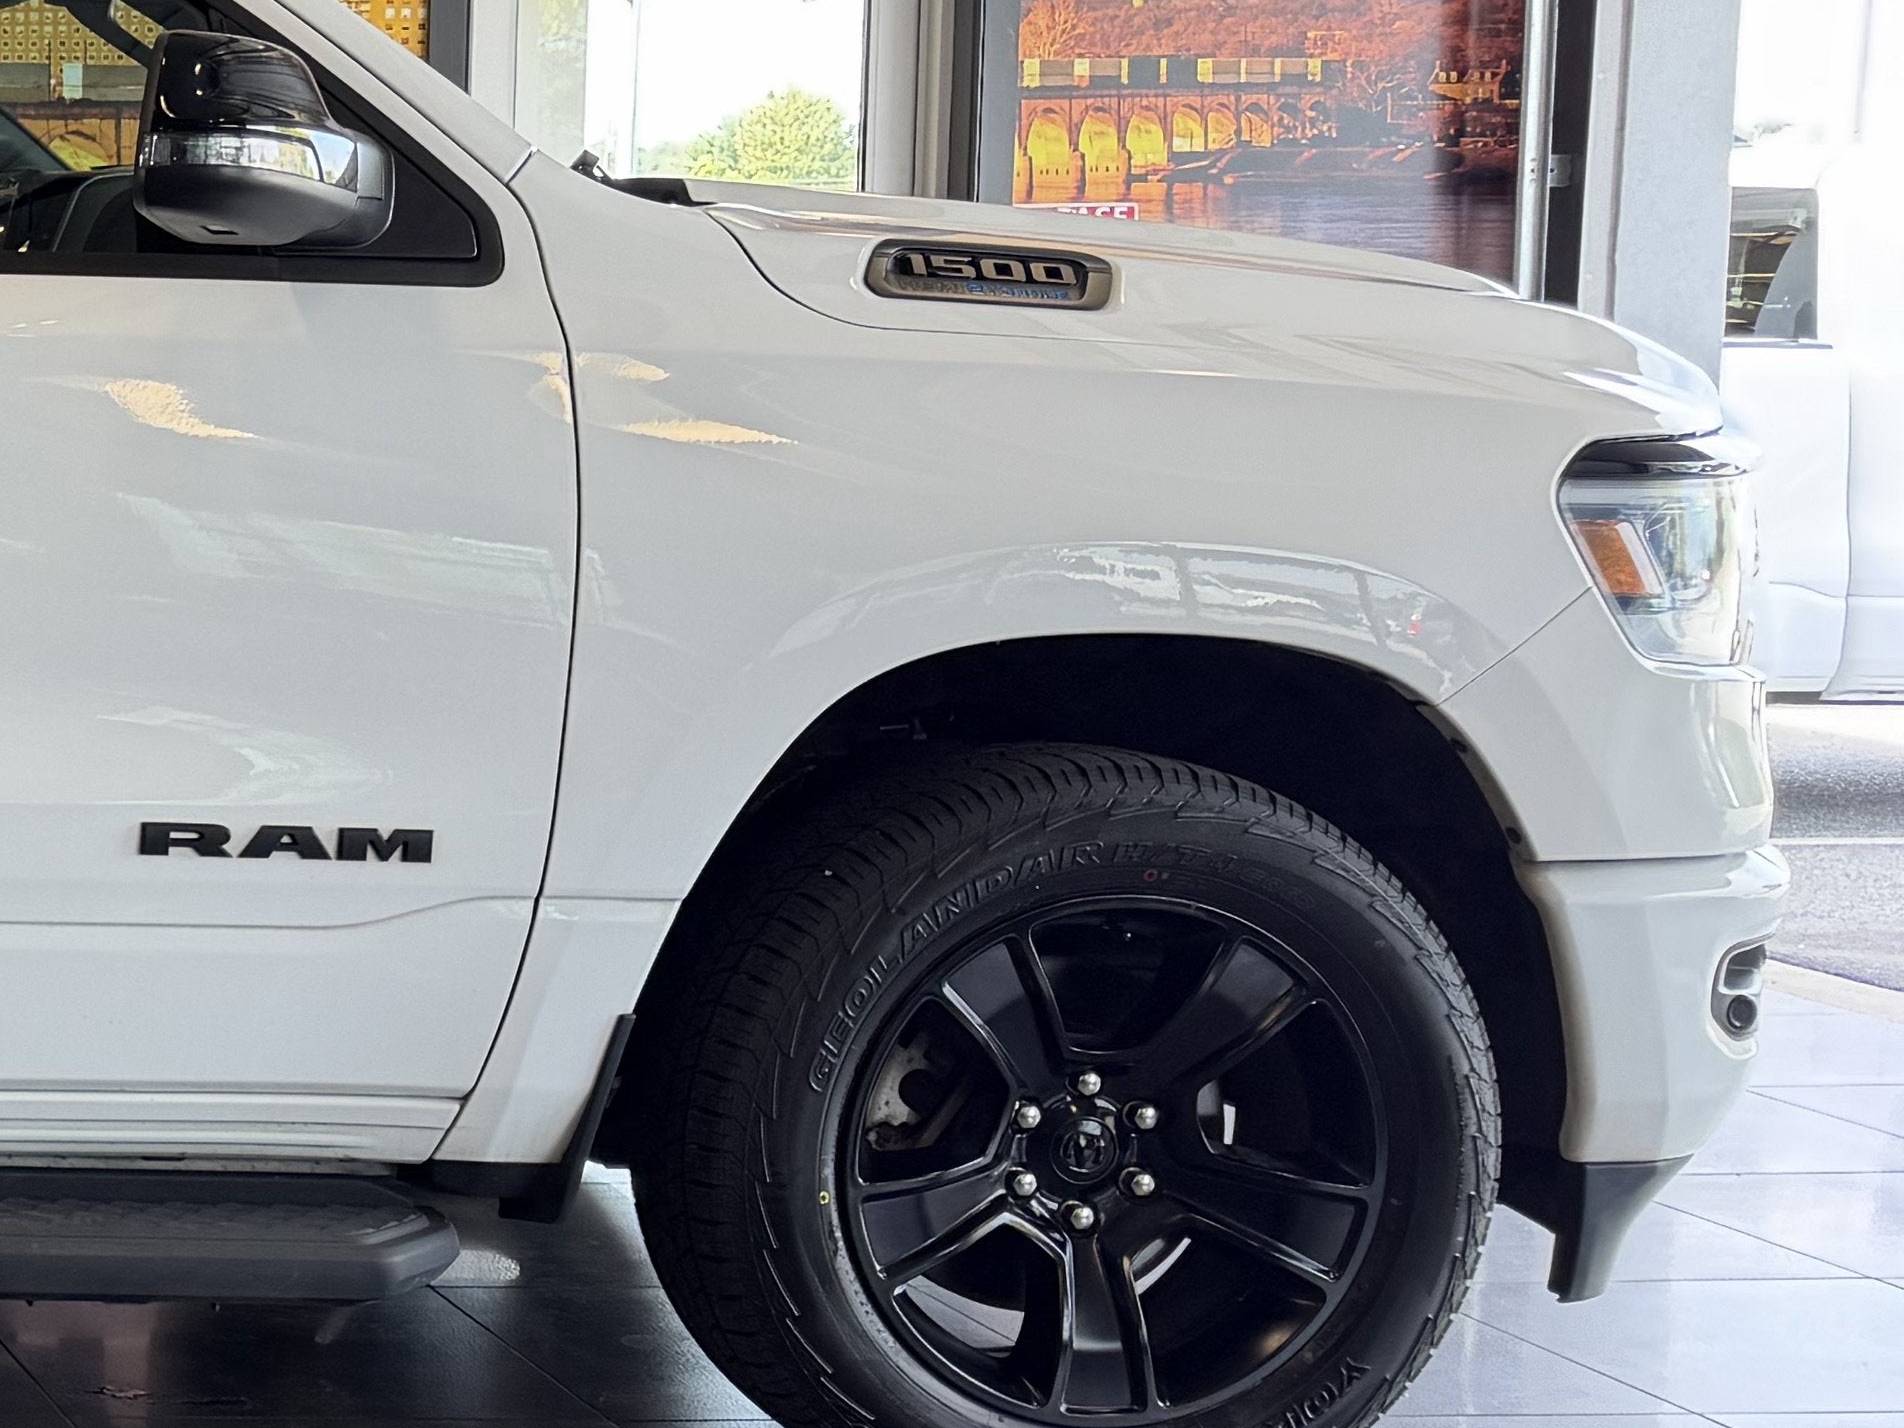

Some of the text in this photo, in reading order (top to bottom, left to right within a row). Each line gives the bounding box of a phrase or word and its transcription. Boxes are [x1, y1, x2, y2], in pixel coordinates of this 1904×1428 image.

[903, 252, 1078, 286] 1500
[138, 821, 435, 864] RAM
[808, 839, 1105, 1093] GEOLANDAR
